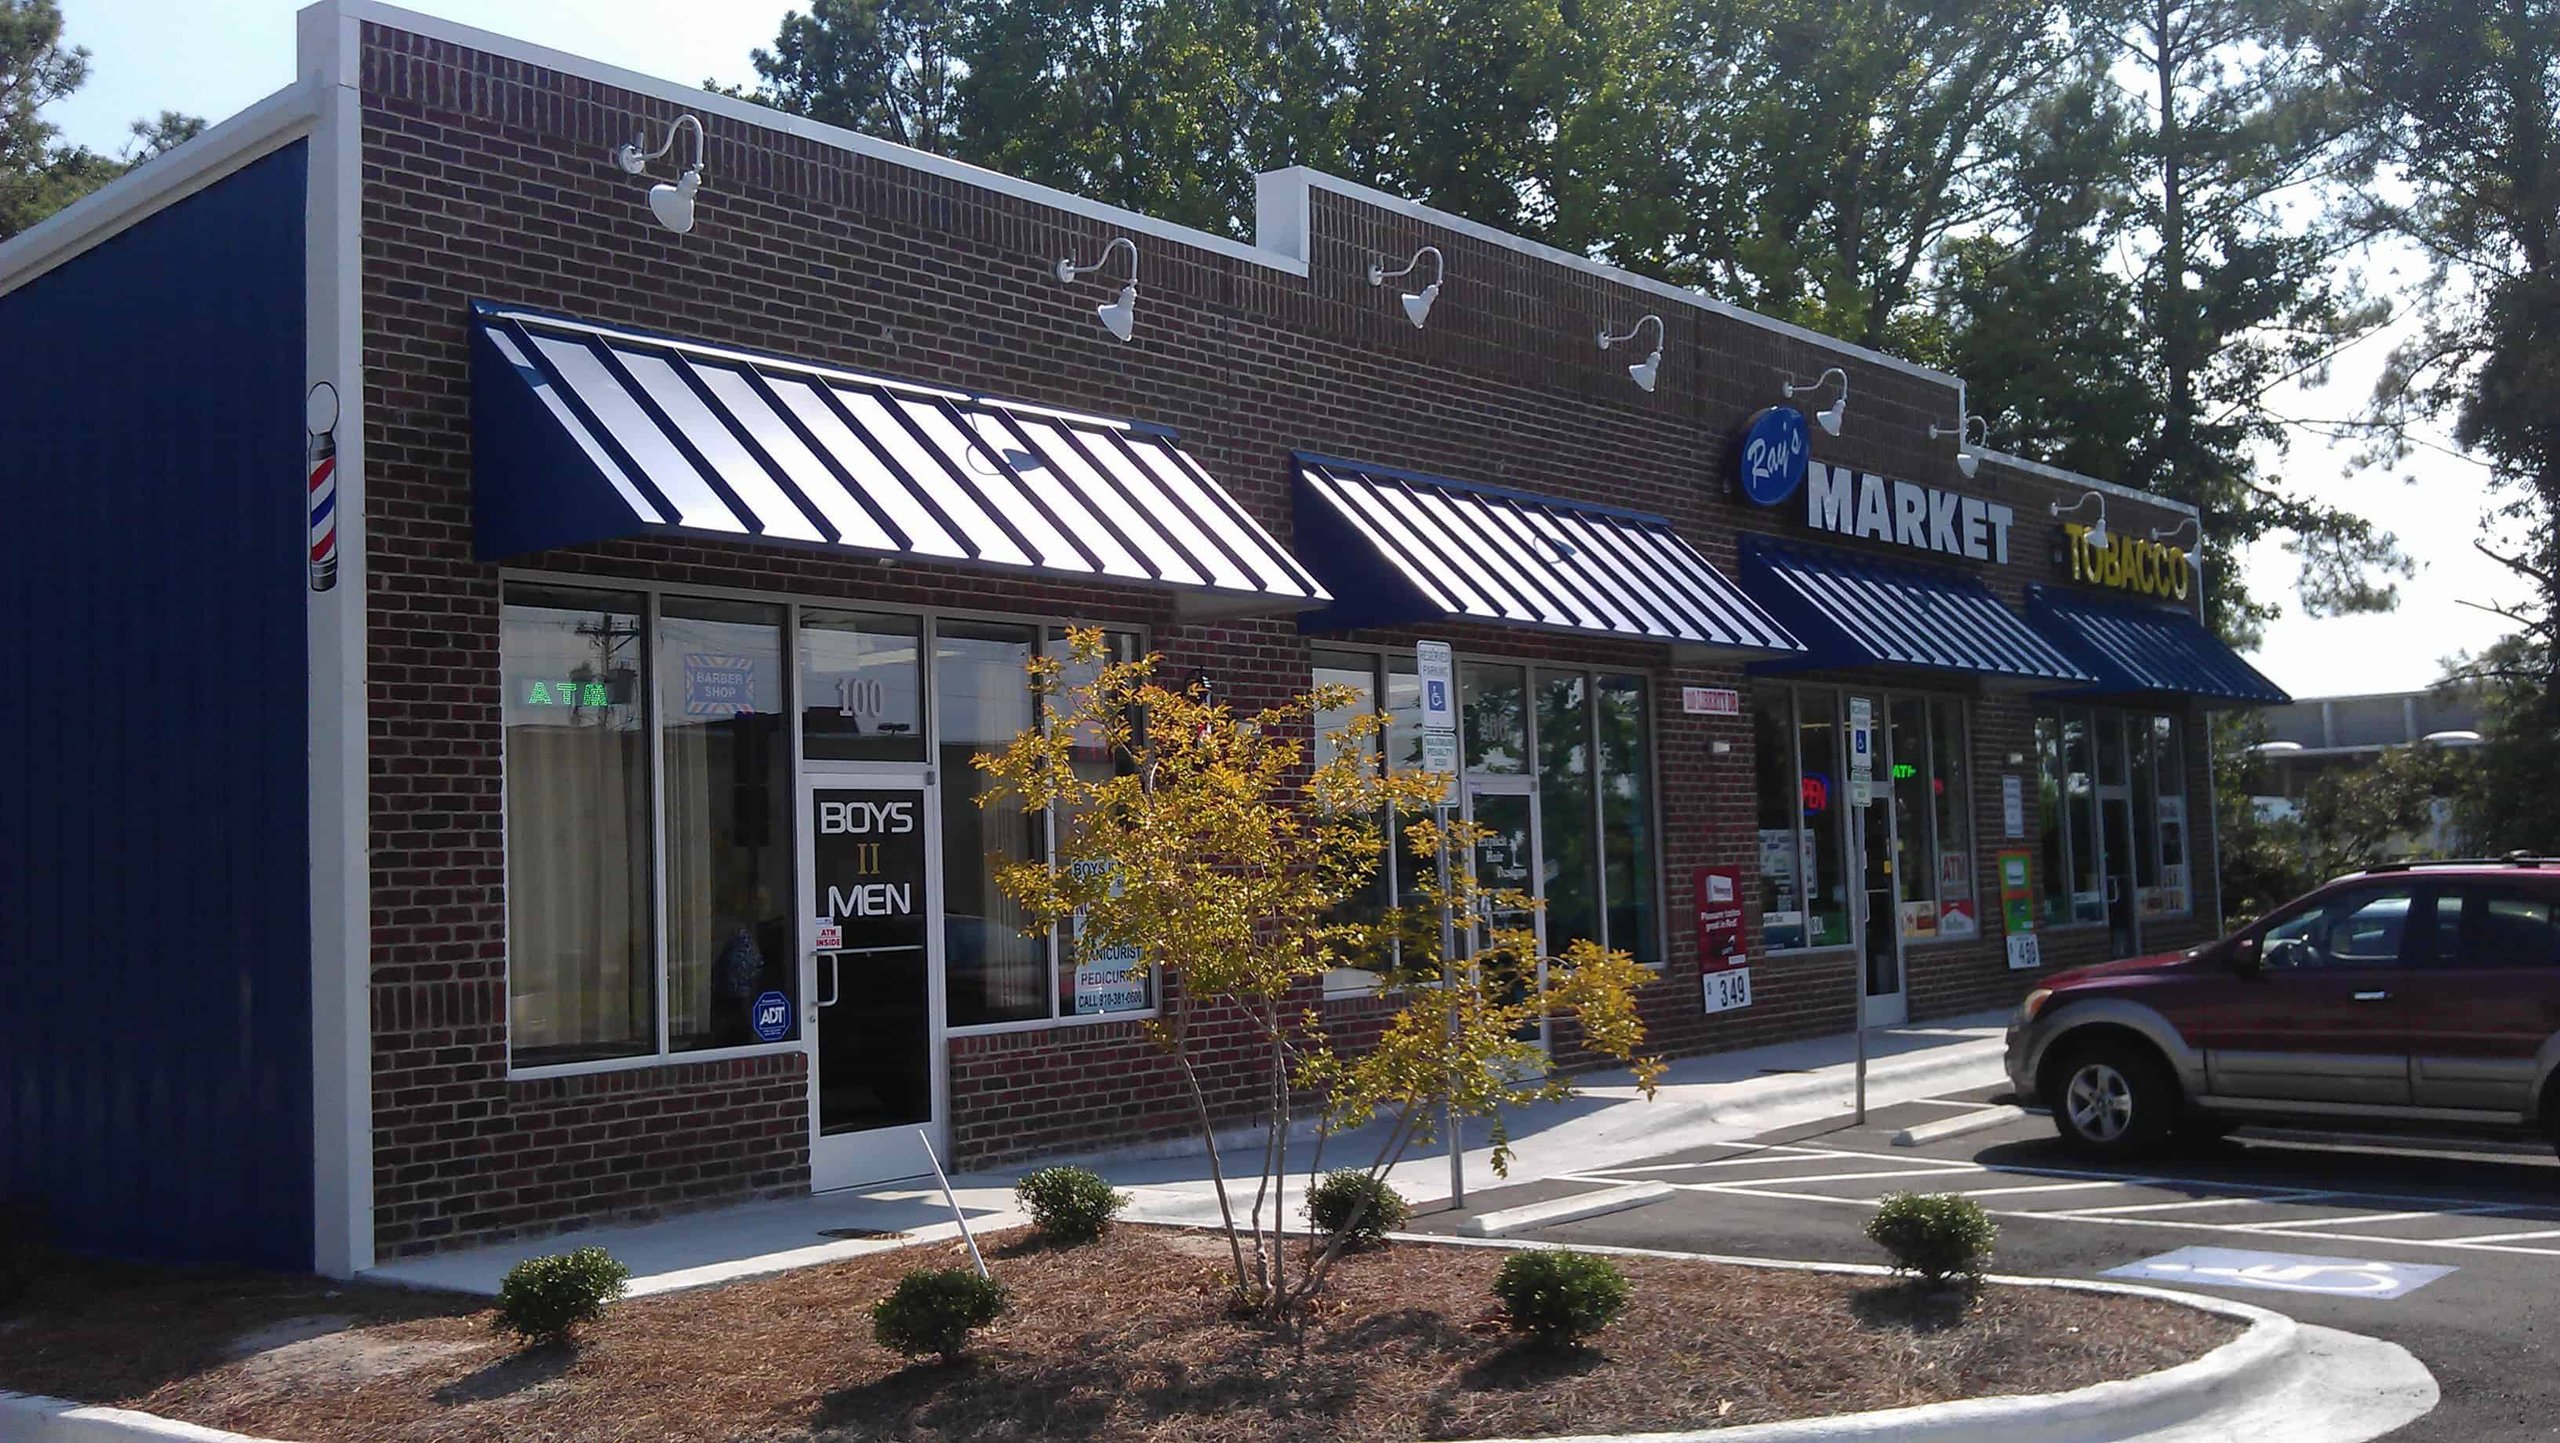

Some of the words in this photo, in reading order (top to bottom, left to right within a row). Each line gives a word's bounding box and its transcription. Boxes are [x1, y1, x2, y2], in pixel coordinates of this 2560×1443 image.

[1747, 422, 1802, 489] Ray's
[1807, 459, 2014, 566] MARKET
[2064, 521, 2189, 601] TOBACCO
[696, 669, 744, 686] BARBER
[528, 682, 608, 707] ATM
[704, 685, 737, 699] SHOP
[839, 677, 885, 717] 100
[1801, 777, 1827, 811] PEN
[820, 802, 913, 834] BOYS
[857, 842, 880, 875] II
[1073, 862, 1106, 876] BOYS
[828, 883, 911, 918] MEN
[816, 937, 842, 947] INSIDE
[821, 928, 837, 937] ATM
[1081, 945, 1142, 961] ANICURIST
[1078, 994, 1098, 1008] CALL
[1720, 975, 1745, 1007] 349
[760, 1006, 785, 1025] ADT
